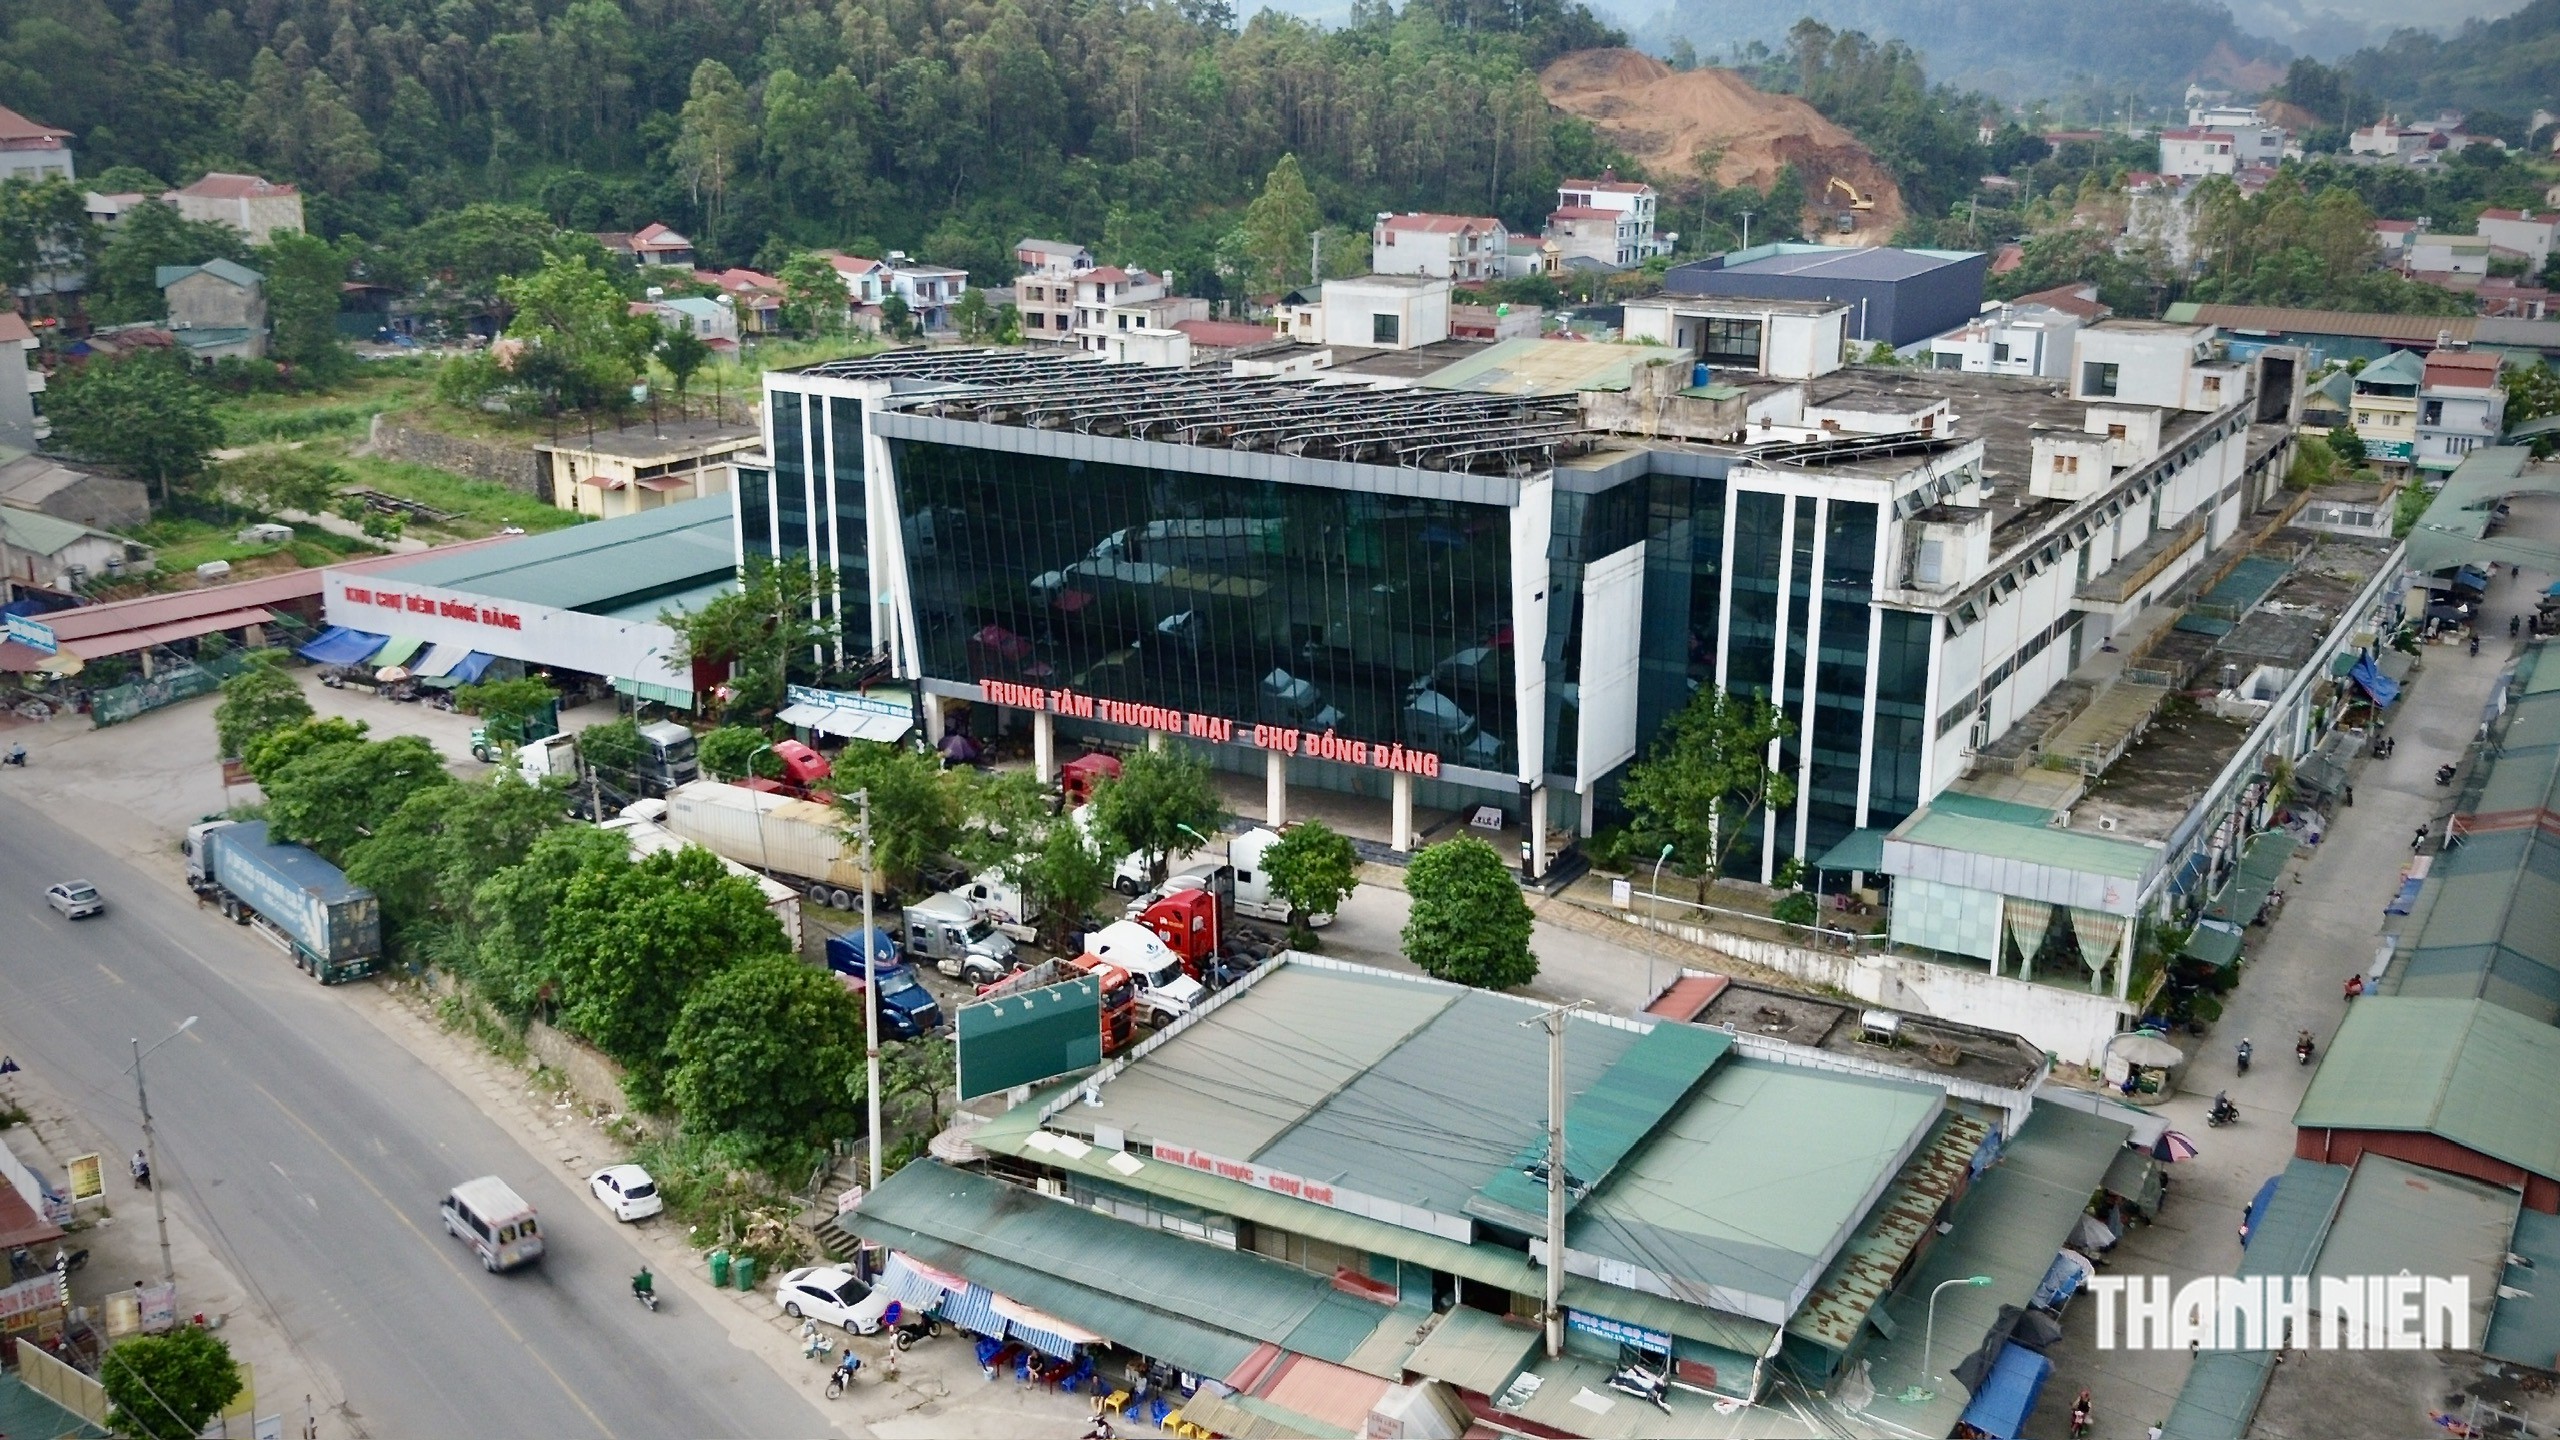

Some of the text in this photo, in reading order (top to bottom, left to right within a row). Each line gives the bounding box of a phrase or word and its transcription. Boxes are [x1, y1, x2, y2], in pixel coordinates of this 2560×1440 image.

[345, 586, 371, 604] KHU
[979, 678, 1044, 710] TRUNG
[1050, 688, 1093, 718] TÂM
[1099, 699, 1182, 733] THƯƠNG
[1188, 713, 1232, 744] MẠI
[1254, 724, 1299, 757] CHỢ
[1305, 728, 1367, 765] ĐỒNG
[1373, 743, 1439, 778] ĐĂNG
[1155, 1145, 1185, 1164] KHU
